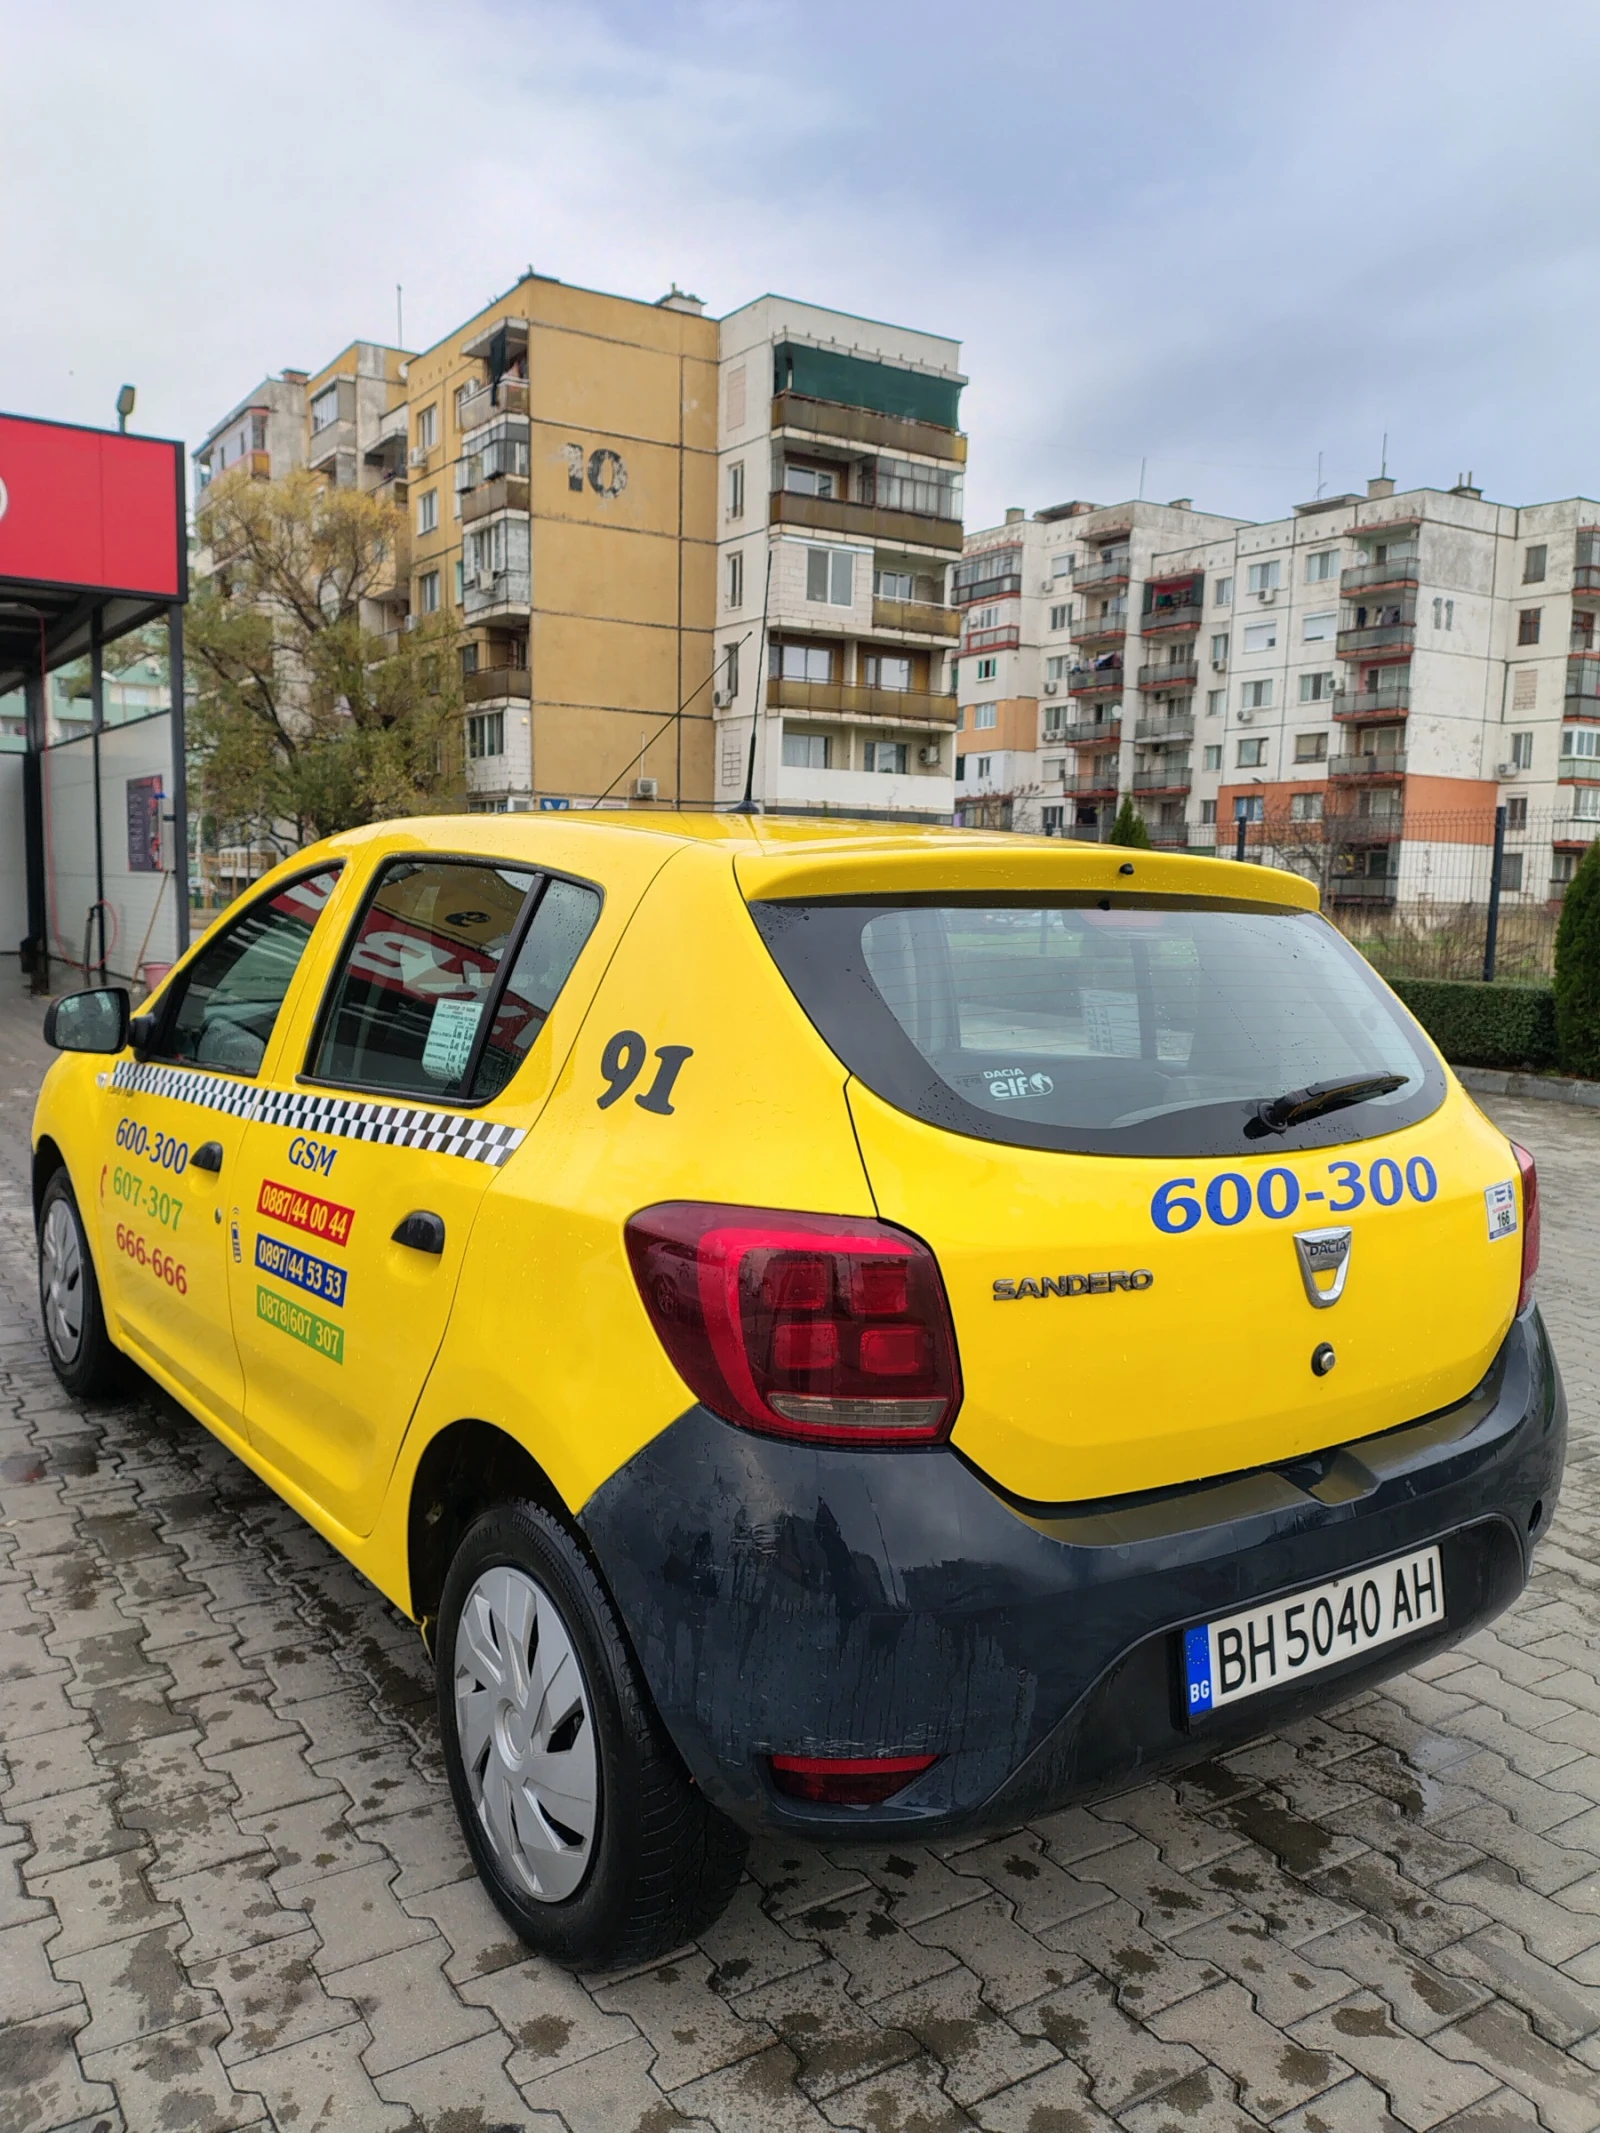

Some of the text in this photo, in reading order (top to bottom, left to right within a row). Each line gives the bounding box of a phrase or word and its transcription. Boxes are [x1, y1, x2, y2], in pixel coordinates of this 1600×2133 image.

[563, 442, 627, 498] 10
[1432, 597, 1454, 631] 11
[596, 1029, 694, 1116] 91
[983, 1068, 1024, 1079] DACIA
[989, 1076, 1029, 1098] elf
[115, 1117, 189, 1175] 600-300
[288, 1136, 338, 1177] GSM
[112, 1166, 184, 1232] 607-307
[1150, 1156, 1438, 1234] 600-300
[310, 1202, 328, 1232] 00
[328, 1208, 349, 1241] 44
[115, 1222, 188, 1296] 666-666
[1309, 1241, 1348, 1257] DACIA
[306, 1262, 323, 1291] 53
[324, 1268, 342, 1300] 53
[992, 1268, 1155, 1301] SANDERO
[315, 1321, 340, 1355] 307
[1190, 1680, 1210, 1703] BG
